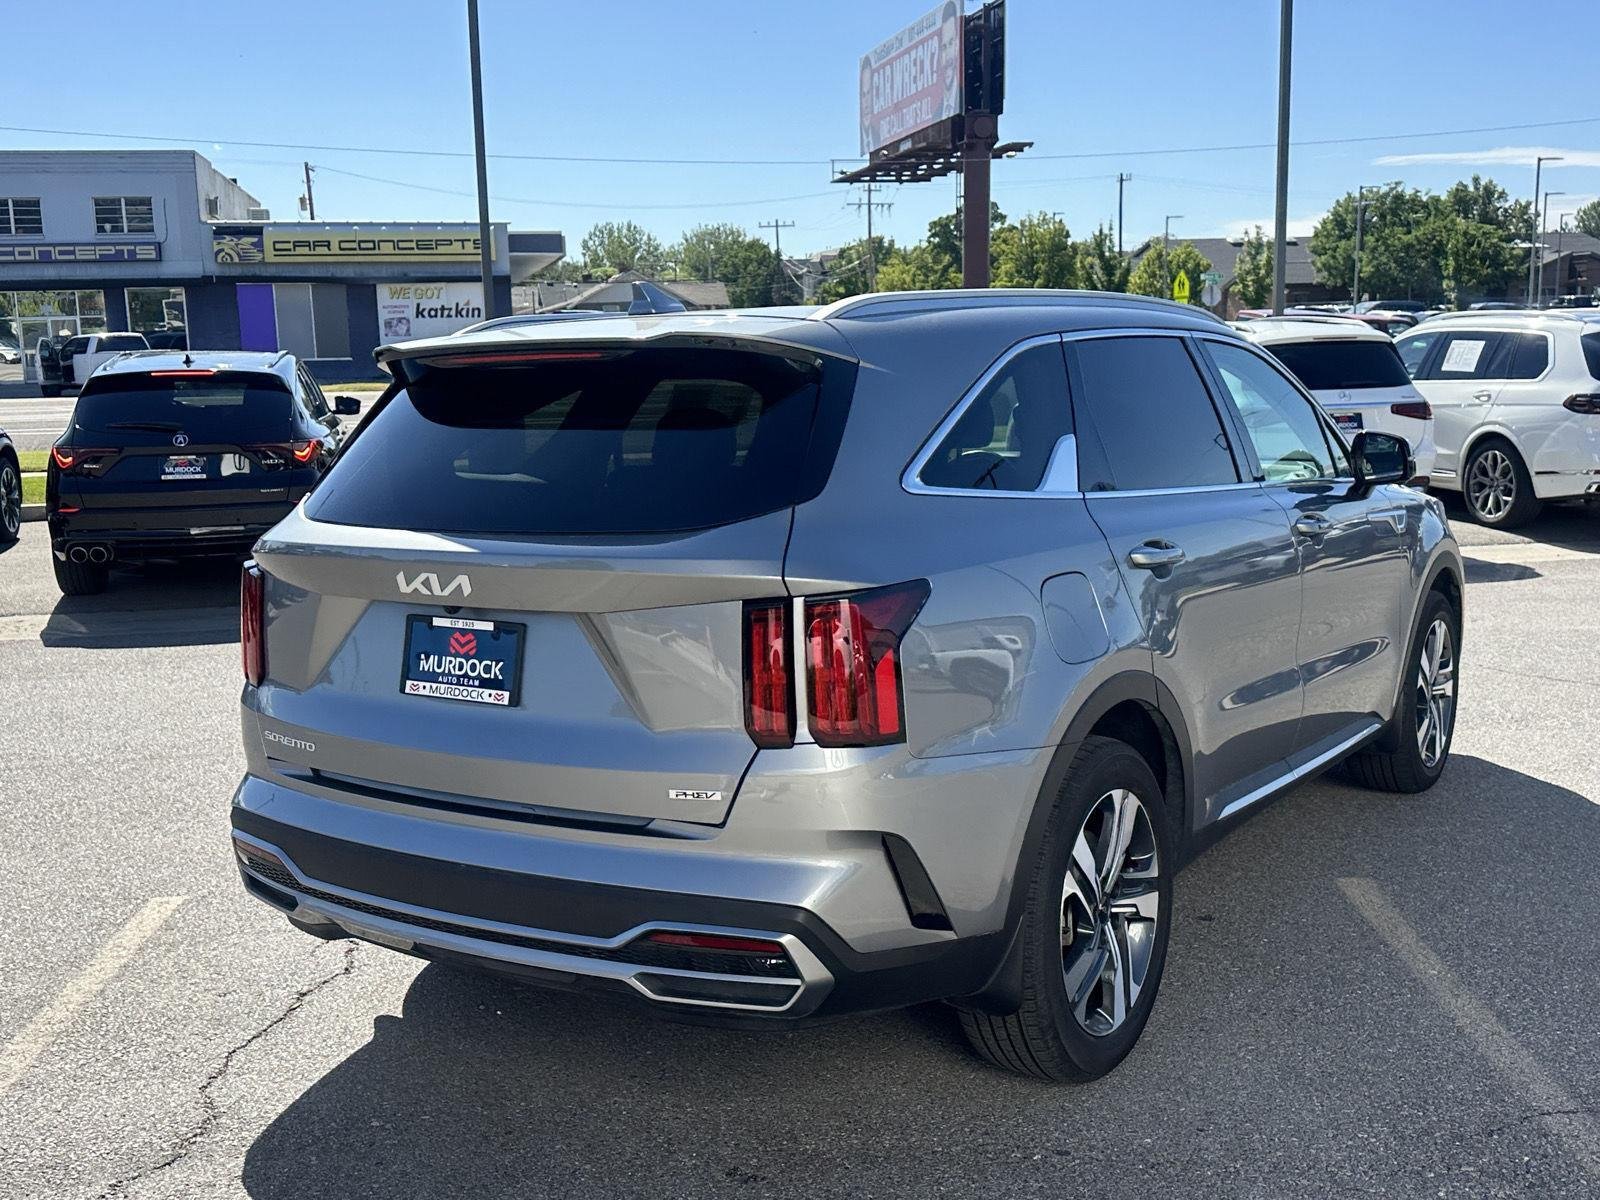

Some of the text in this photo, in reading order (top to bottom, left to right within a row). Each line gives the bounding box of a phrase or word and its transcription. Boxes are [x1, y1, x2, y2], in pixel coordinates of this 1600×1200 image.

[873, 64, 892, 114] CAR
[893, 36, 938, 102] WRECK?
[272, 240, 332, 252] CAR
[388, 286, 443, 299] WE GOT
[416, 300, 482, 319] katzkin
[165, 466, 202, 474] MURDOCK
[396, 571, 472, 597] KIA
[419, 653, 504, 680] MURDOCK
[438, 676, 480, 686] AUTO TEAM
[429, 684, 485, 700] MURDOCK
[264, 730, 315, 752] SORENTO
